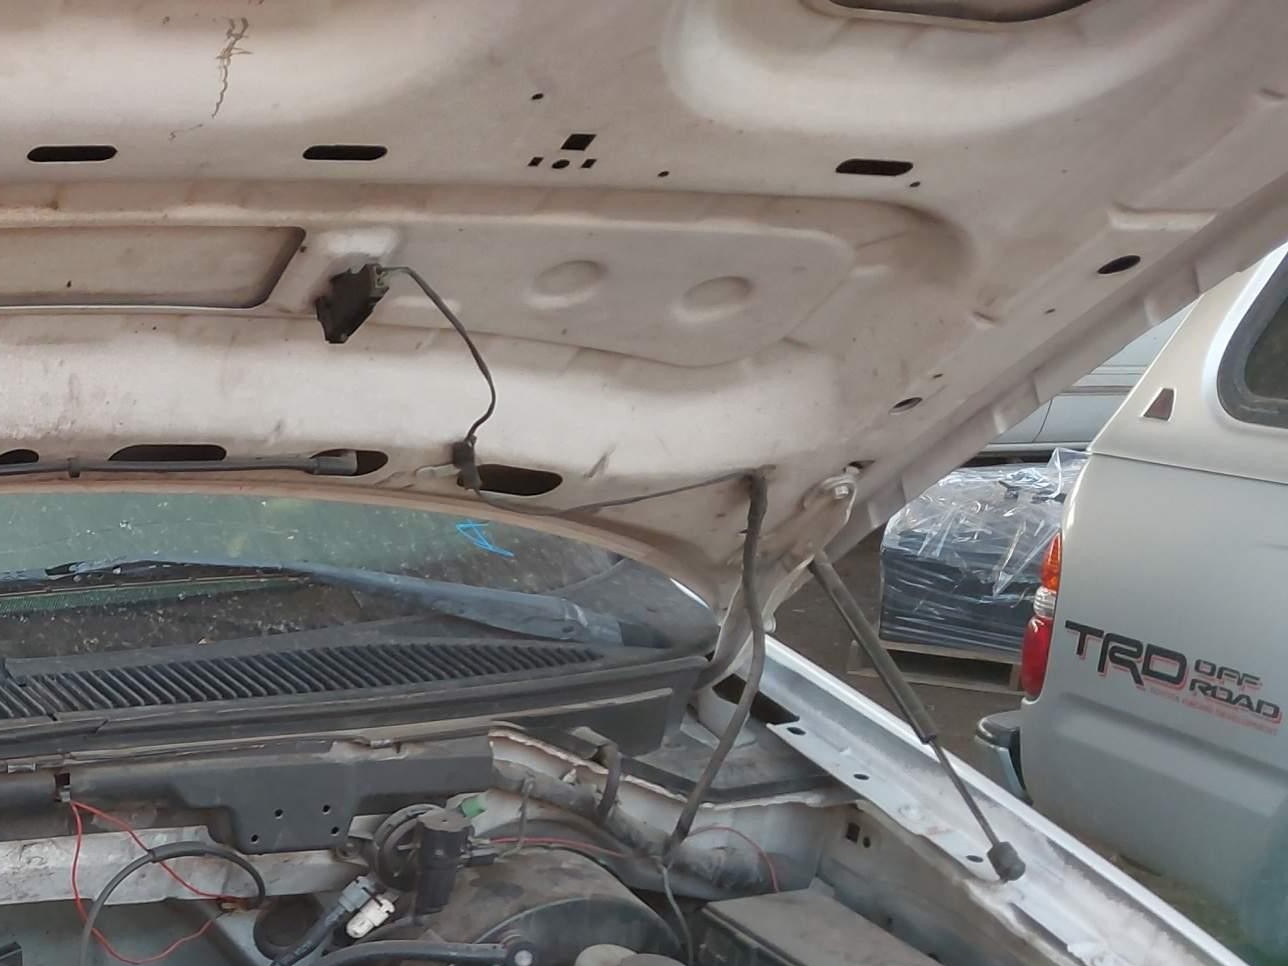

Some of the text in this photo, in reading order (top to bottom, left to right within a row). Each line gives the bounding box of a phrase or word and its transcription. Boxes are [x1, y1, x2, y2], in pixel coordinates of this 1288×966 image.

[1065, 620, 1189, 689] TRD
[1194, 659, 1262, 688] OFF
[1190, 678, 1282, 721] ROAD
